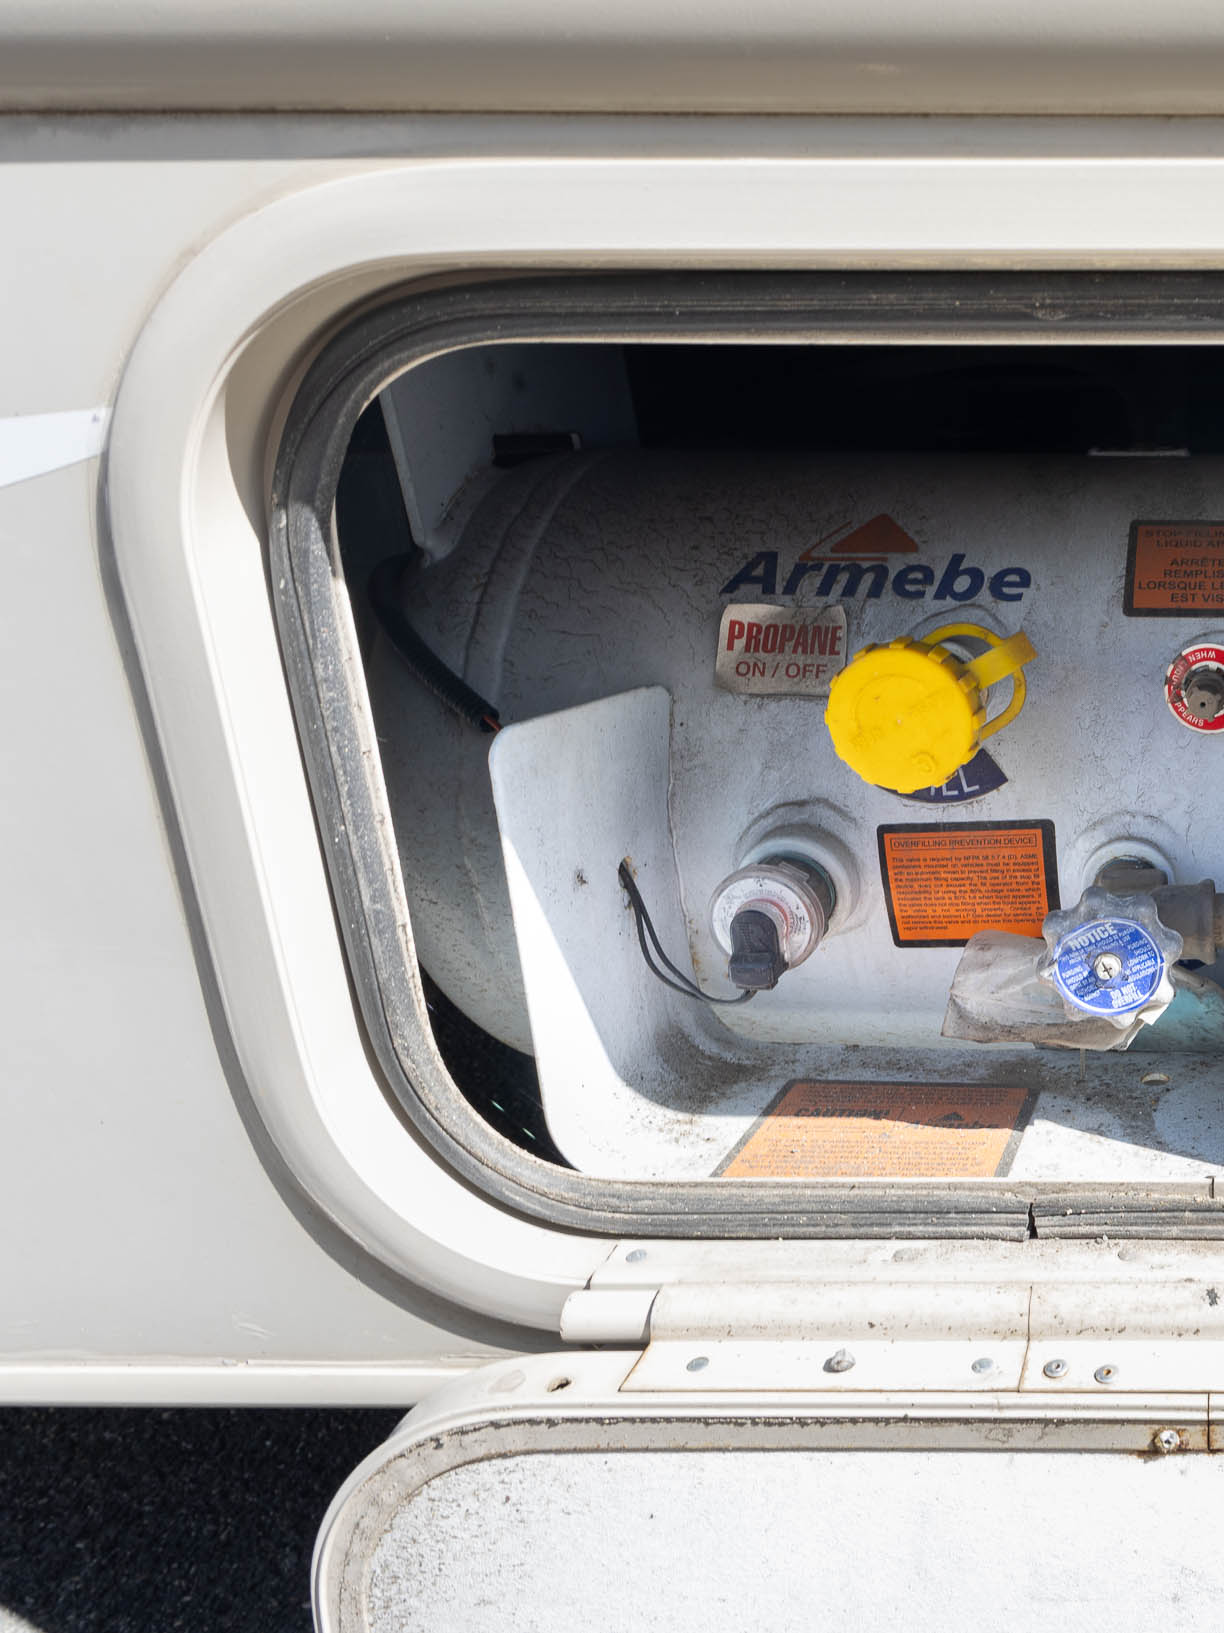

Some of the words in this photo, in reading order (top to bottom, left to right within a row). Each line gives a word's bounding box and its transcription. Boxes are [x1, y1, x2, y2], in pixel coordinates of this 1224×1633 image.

[1156, 539, 1202, 549] LIQUID
[719, 551, 1031, 601] Armebe
[1138, 581, 1206, 591] LORSQUE
[1170, 593, 1197, 603] EST
[727, 619, 843, 657] PROPANE
[1188, 650, 1216, 663] WHEN
[735, 661, 765, 678] ON
[771, 661, 778, 677] /
[785, 662, 827, 679] OFF
[1174, 701, 1204, 727] PPEARS
[893, 839, 948, 849] OVERFILLING
[949, 838, 1002, 848] PREVENTION
[1003, 837, 1034, 846] DEVICE
[1068, 923, 1118, 950] NOTICE
